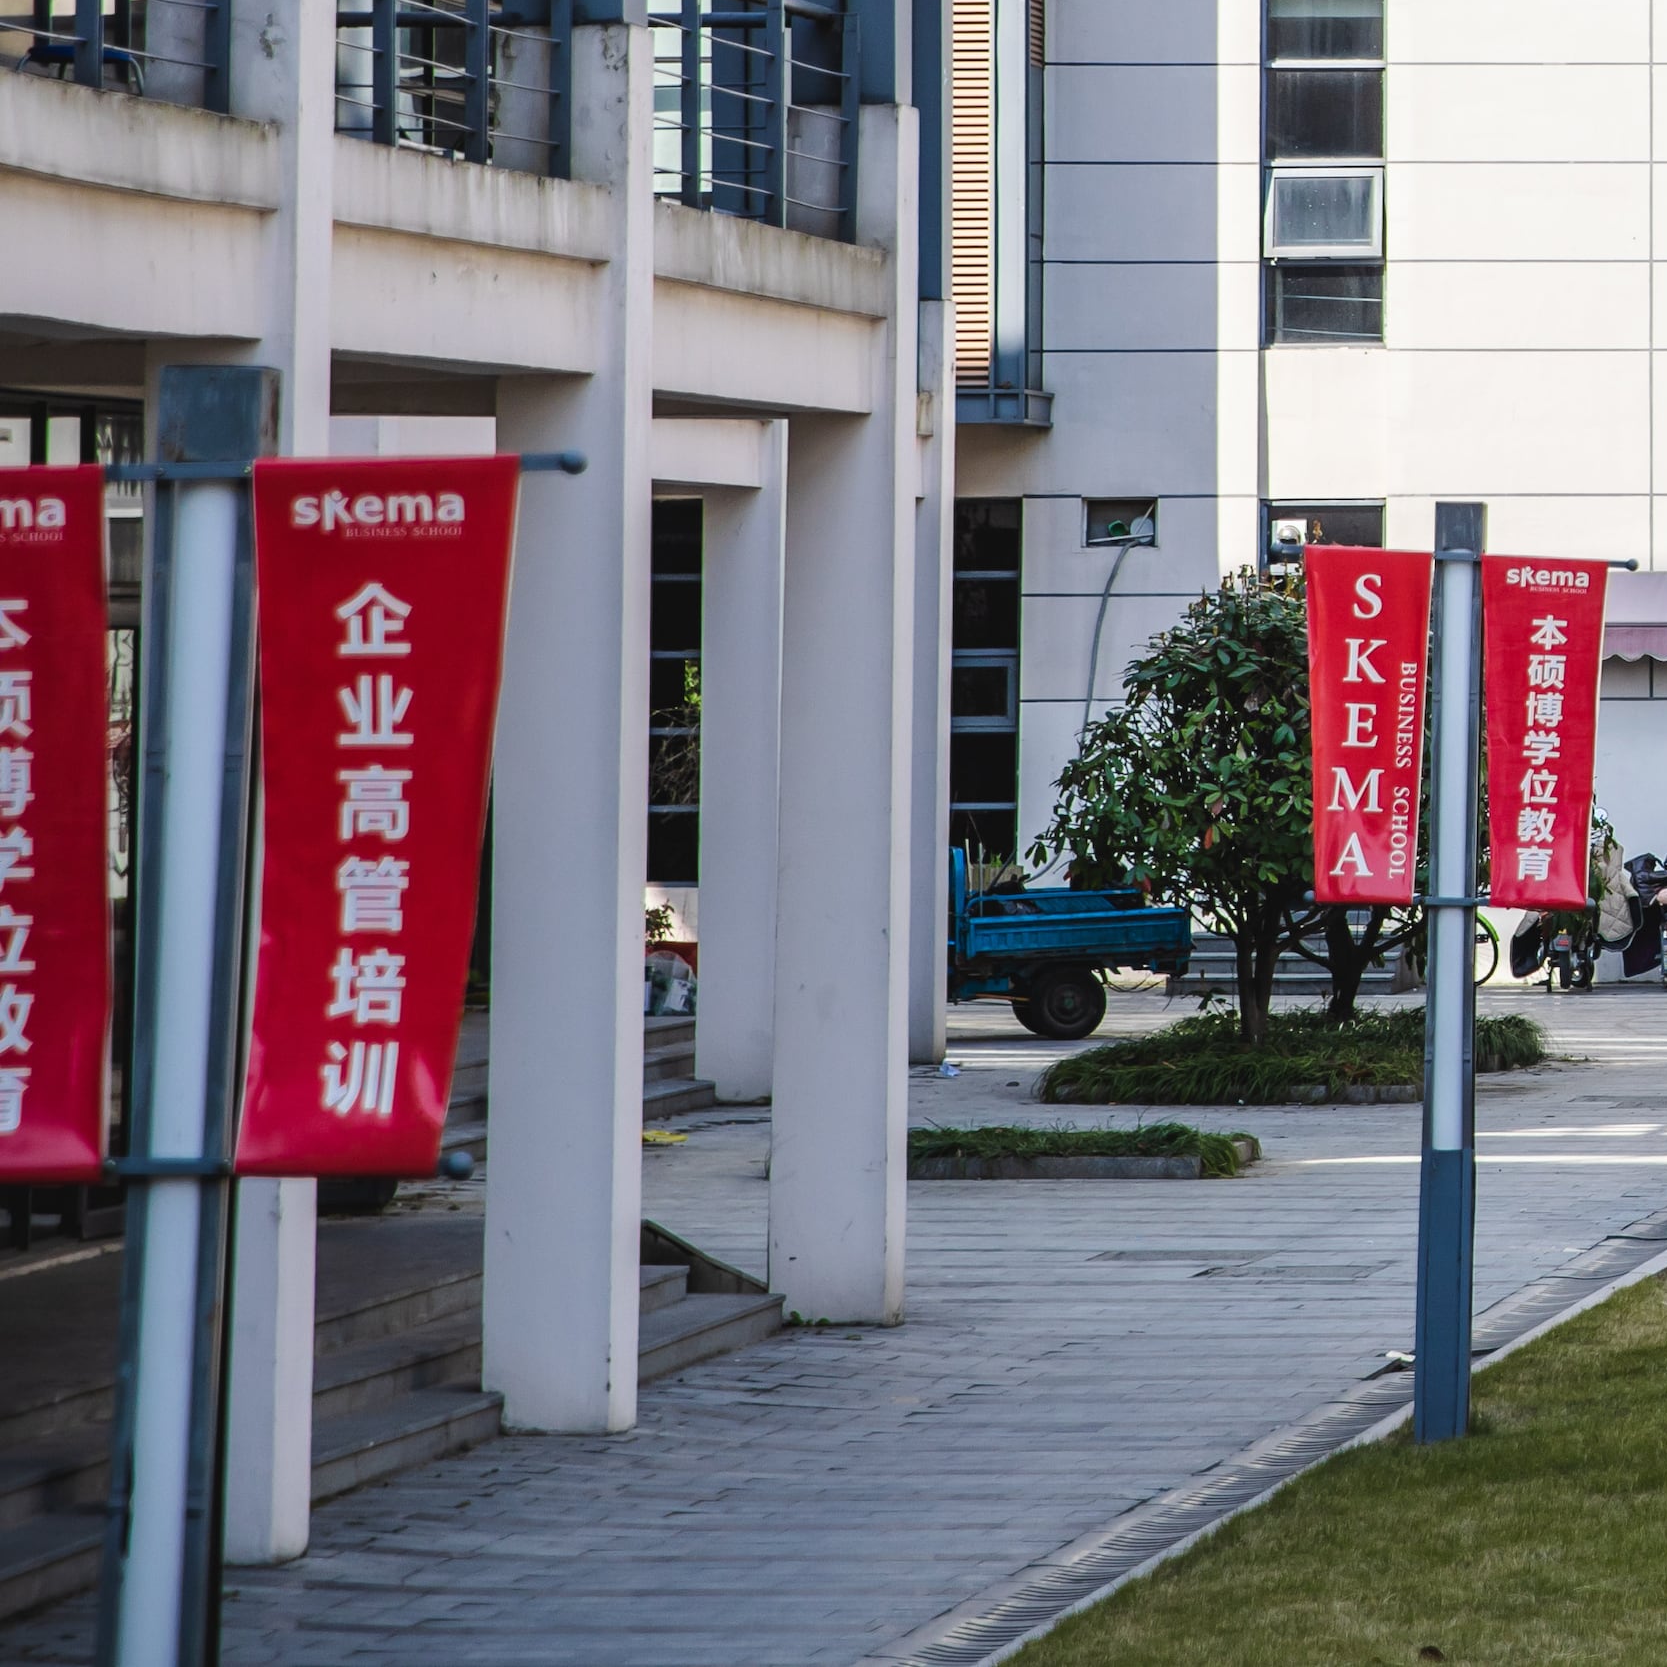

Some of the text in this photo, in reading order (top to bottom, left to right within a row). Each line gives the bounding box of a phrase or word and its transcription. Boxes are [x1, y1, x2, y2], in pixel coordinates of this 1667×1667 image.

[293, 490, 465, 531] skema
[1506, 566, 1590, 588] skema
[1327, 573, 1387, 877] SKEMA
[1389, 661, 1417, 879] BUSINESS SCHOOL
[1516, 615, 1568, 881] 本硕博学位教育
[321, 583, 414, 1116] 企业高管培训
